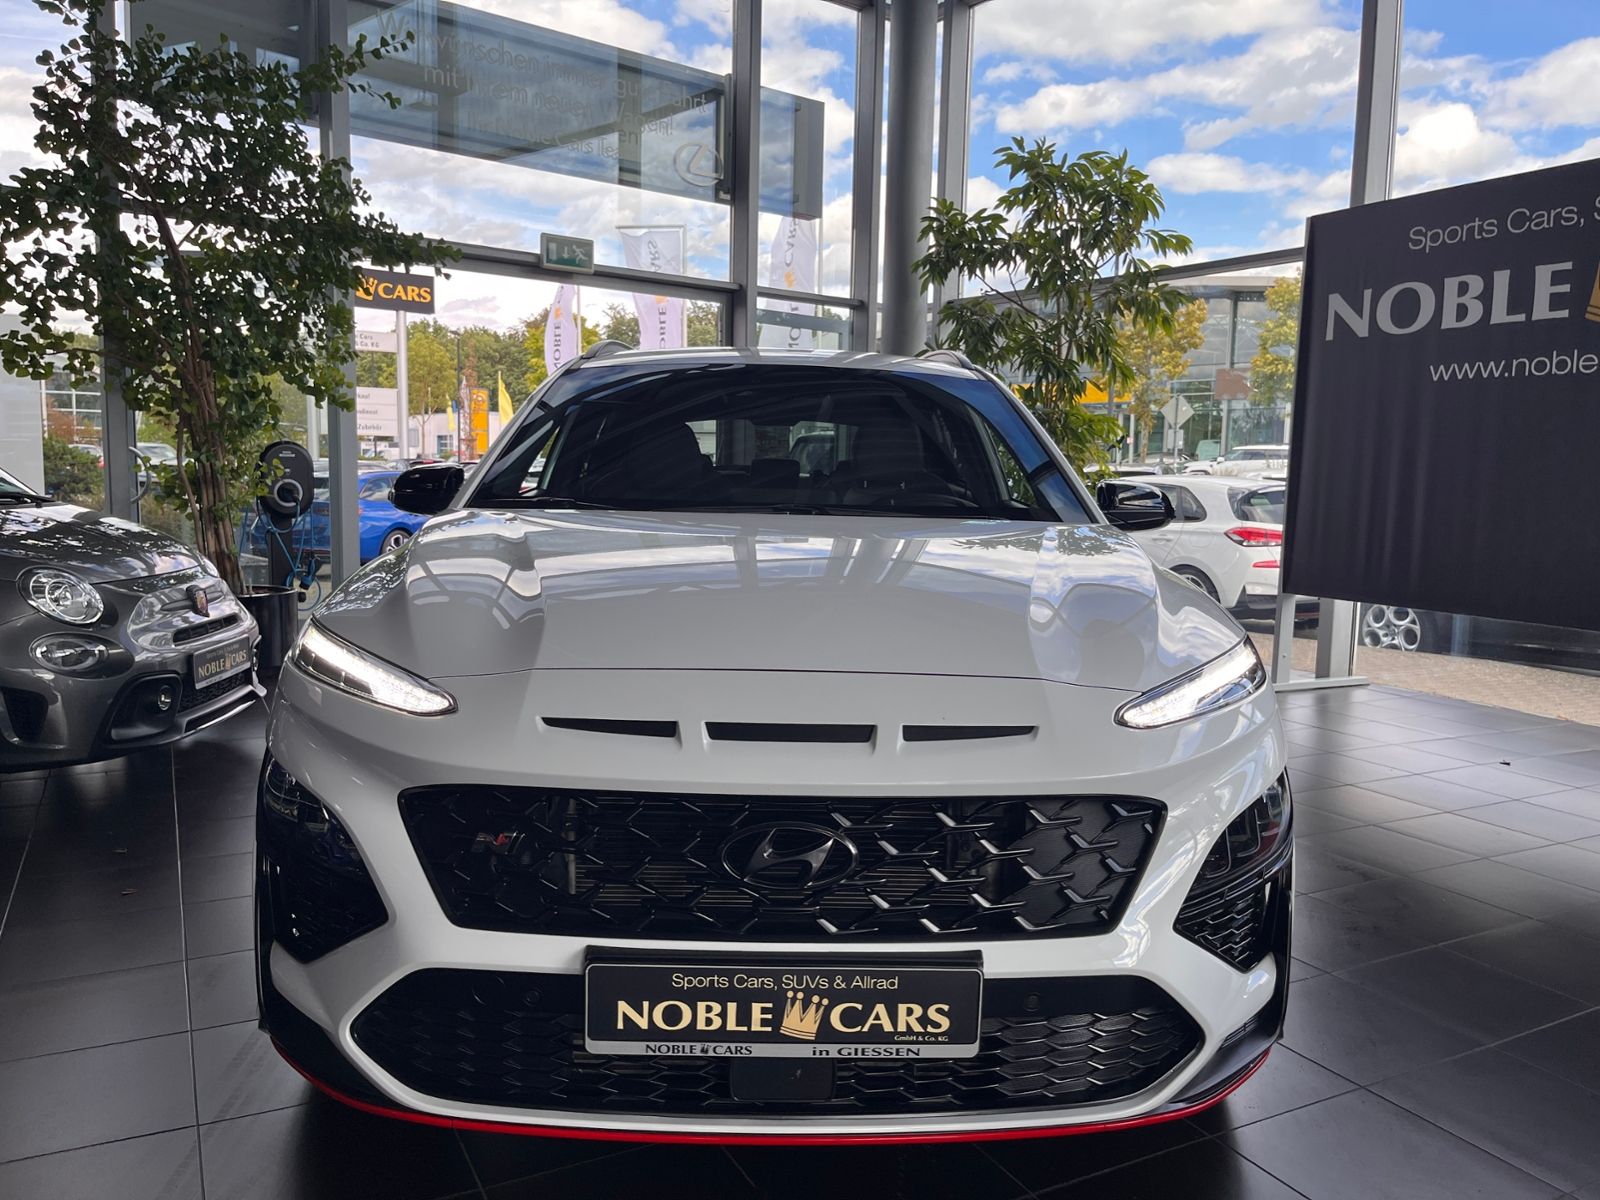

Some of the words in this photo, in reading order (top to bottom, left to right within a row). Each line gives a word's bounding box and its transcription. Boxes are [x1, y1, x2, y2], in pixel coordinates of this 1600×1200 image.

[425, 65, 459, 89] mit
[1408, 217, 1498, 253] Sports
[1507, 204, 1585, 235] Cars,
[377, 282, 432, 303] CARS
[1325, 260, 1573, 342] NOBLE
[198, 658, 225, 678] NOBLE
[231, 649, 247, 666] CARS
[671, 973, 729, 990] Sports
[733, 973, 778, 991] Cars,
[781, 975, 829, 990] SUVs
[833, 976, 847, 990] &
[850, 975, 899, 991] Allrad
[616, 1000, 773, 1032] NOBLE
[830, 1002, 951, 1034] CARS
[645, 1044, 697, 1055] NOBLE
[712, 1045, 753, 1056] CARS
[812, 1046, 830, 1056] in
[836, 1047, 921, 1057] GIESSEN
